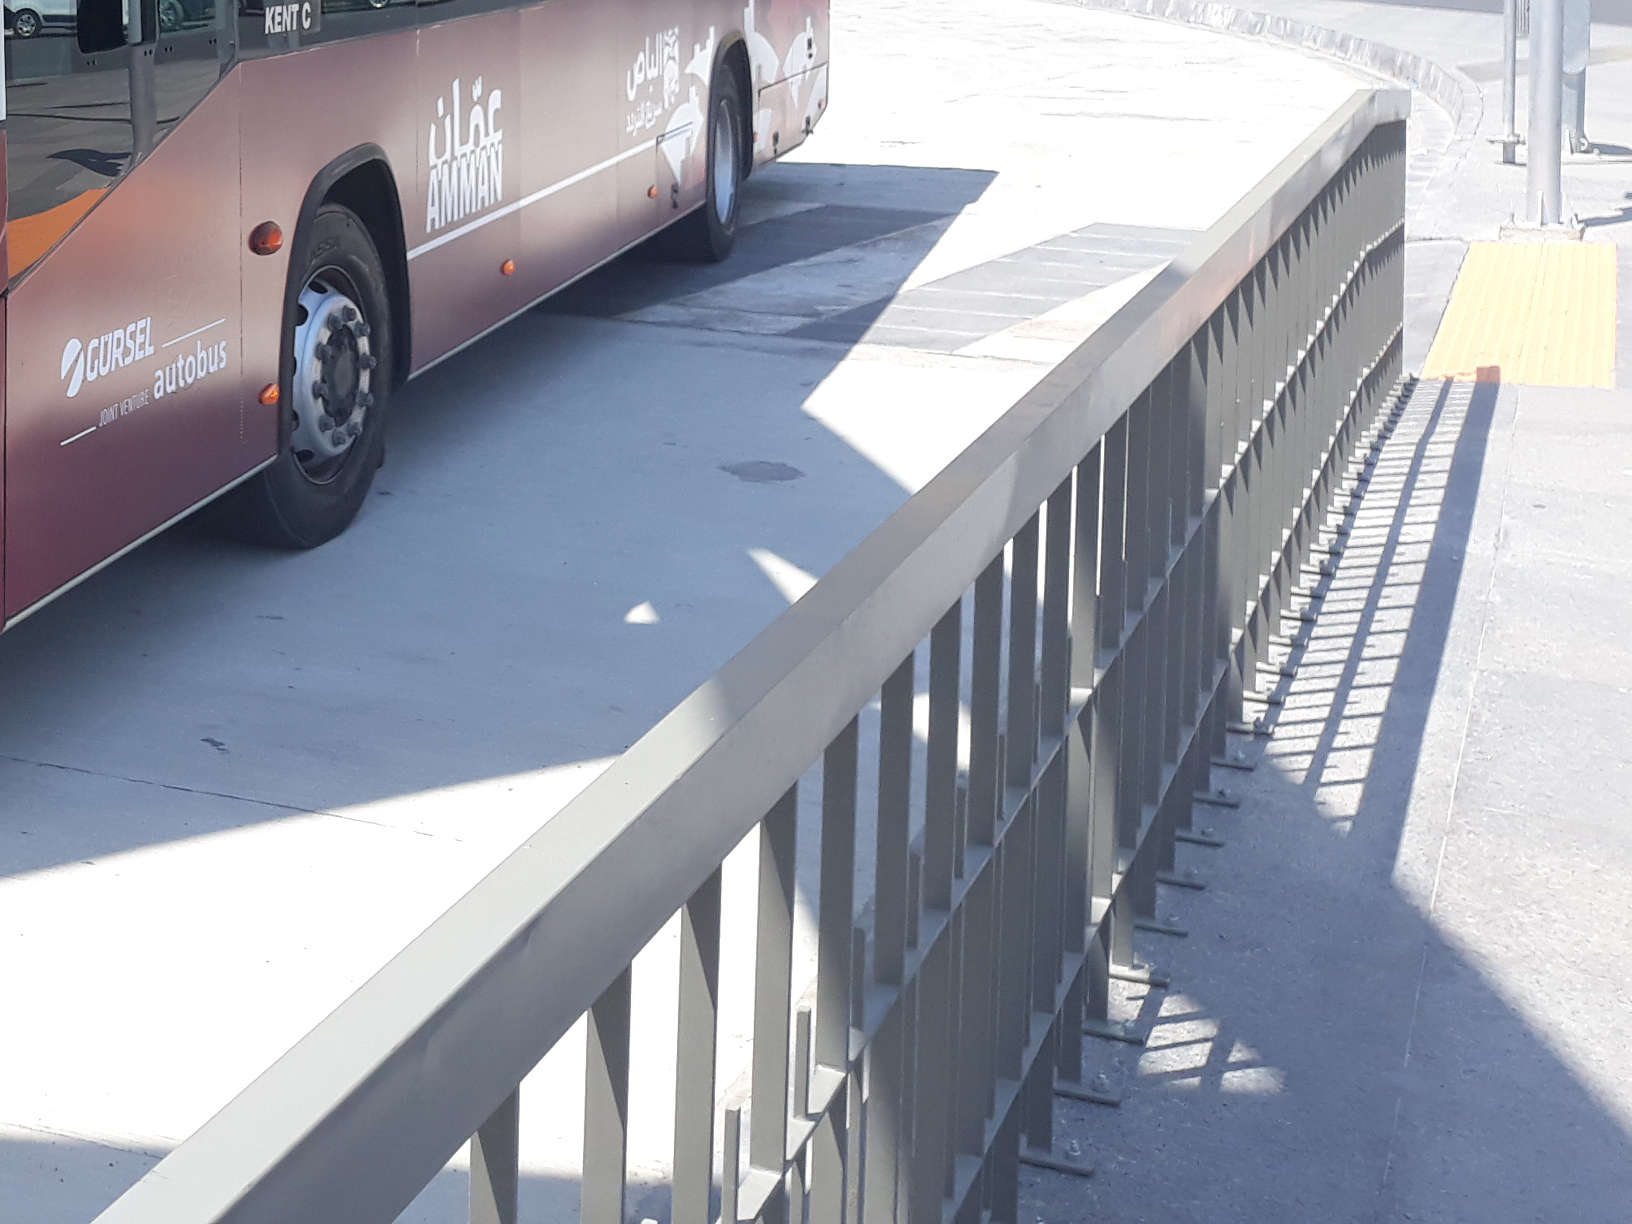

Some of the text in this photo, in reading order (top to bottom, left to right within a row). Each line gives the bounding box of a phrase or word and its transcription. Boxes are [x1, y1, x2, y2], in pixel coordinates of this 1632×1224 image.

[264, 1, 312, 35] KENT C
[426, 143, 503, 233] AMMAN
[86, 316, 155, 383] GÜRSEL
[153, 339, 228, 400] autobus
[99, 388, 150, 427] JOINT VENTURE
